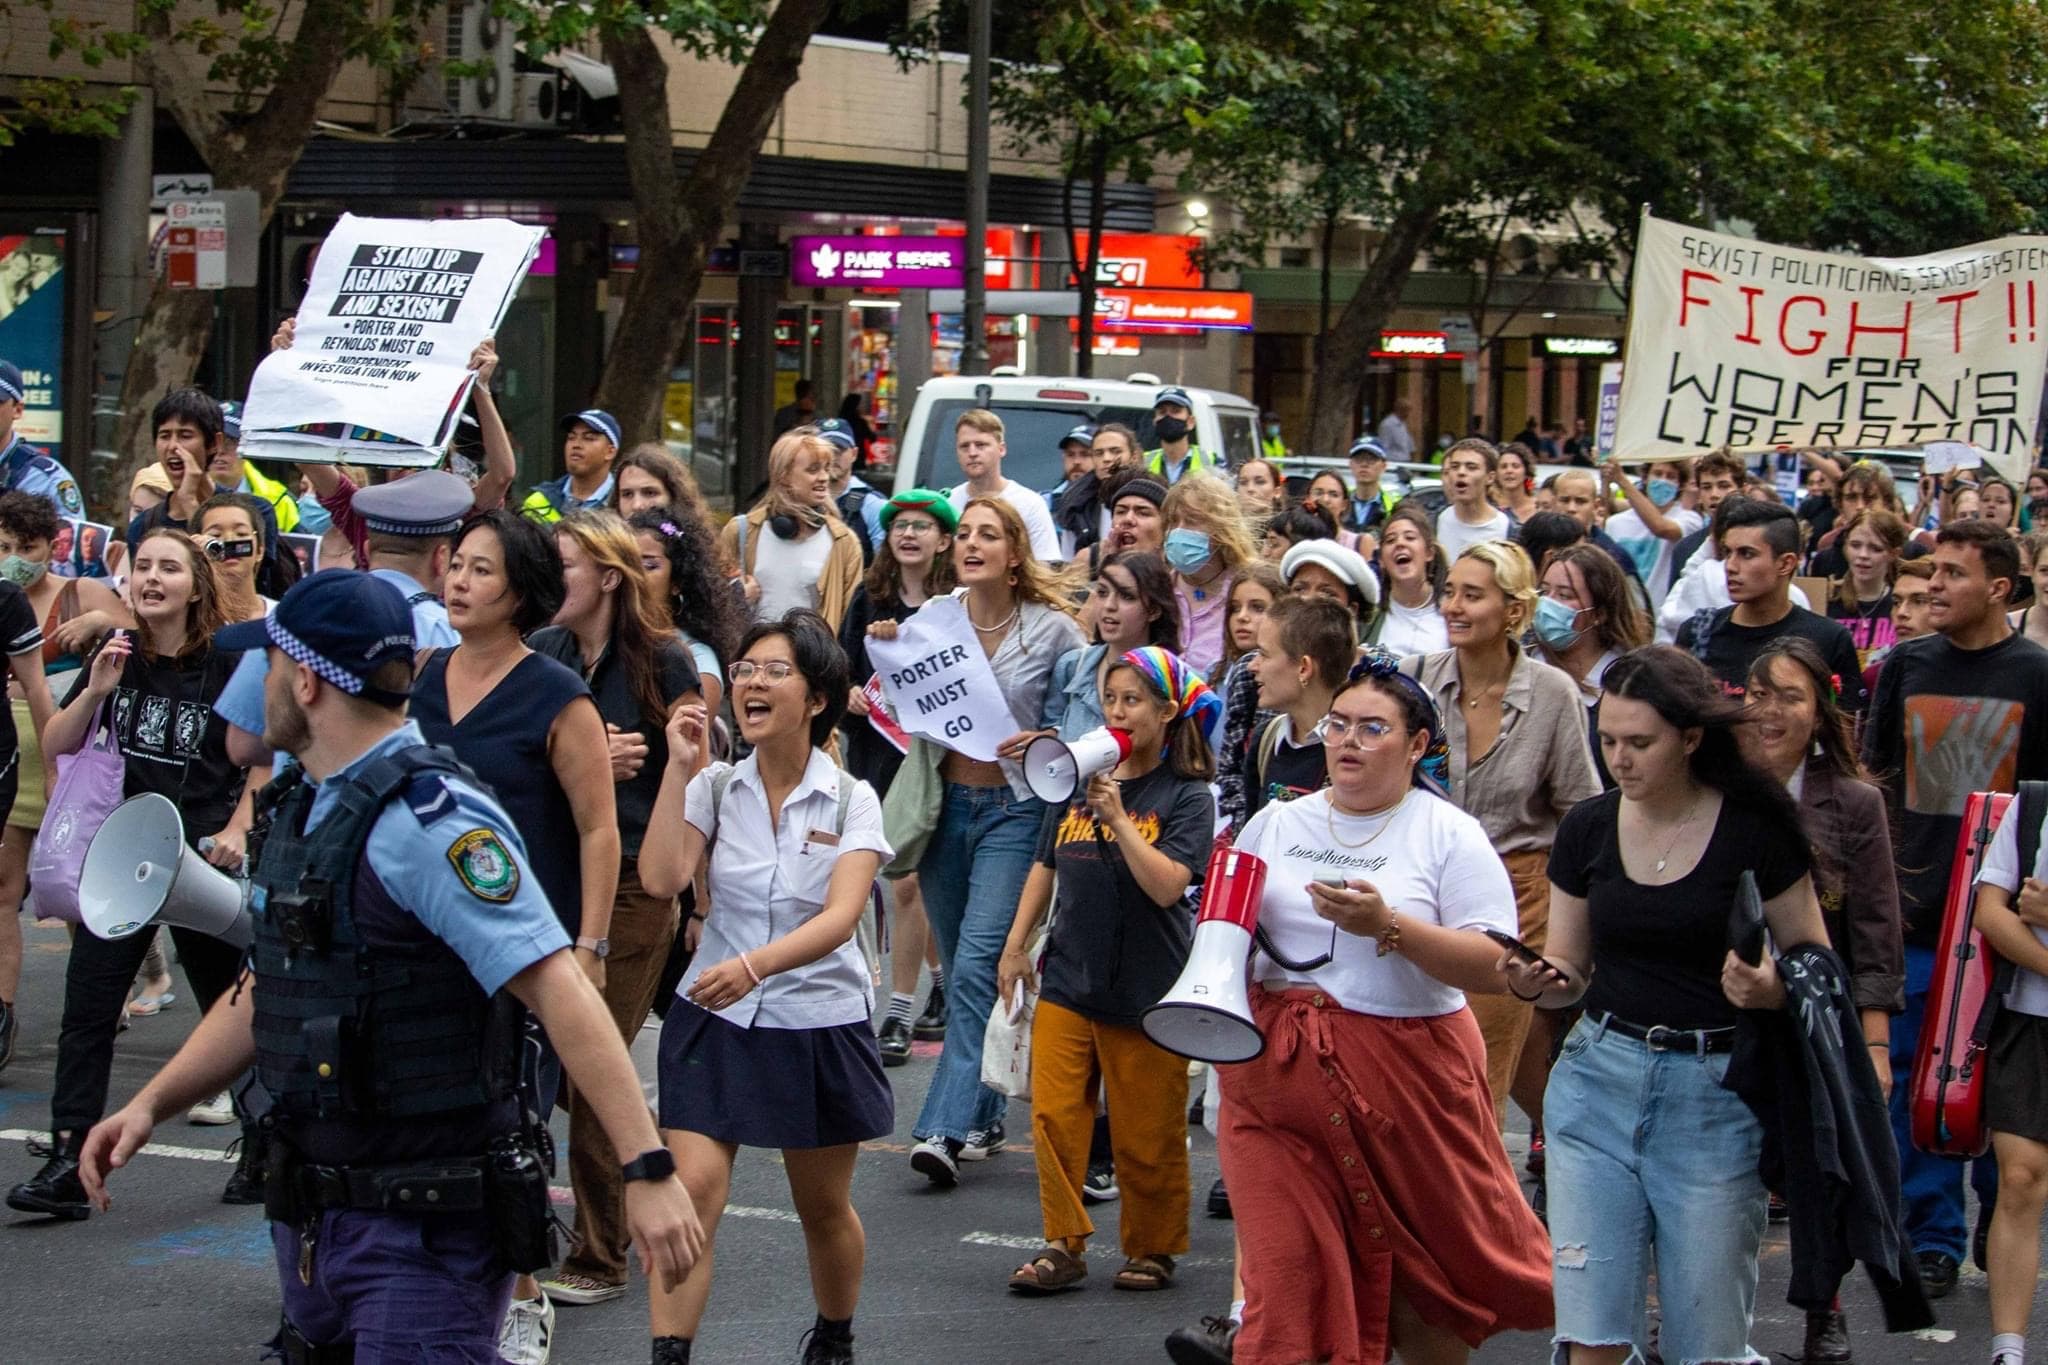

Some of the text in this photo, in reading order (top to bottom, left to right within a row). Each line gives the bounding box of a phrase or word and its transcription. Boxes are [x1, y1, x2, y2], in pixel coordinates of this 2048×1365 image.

[372, 246, 461, 270] STAND UP
[843, 251, 893, 269] PARK
[1682, 236, 1762, 276] SEXIST
[1920, 257, 1981, 291] SEXIST
[342, 268, 471, 297] AGAINST RAPE
[338, 295, 449, 321] AND SEXISM
[1679, 268, 1980, 360] FIGHT
[352, 320, 423, 337] PORTER AND
[321, 336, 434, 356] REYNOLDS MUST GO
[299, 362, 421, 383] INVESTIGATION NOW
[336, 355, 412, 368] INDEPENDENT
[1826, 358, 1921, 379] FOR
[1668, 352, 2019, 421] WOMEN'S
[1659, 398, 2027, 455] LIBERATION
[890, 644, 969, 690] PORTER
[915, 678, 968, 715] MUST
[944, 715, 973, 739] GO
